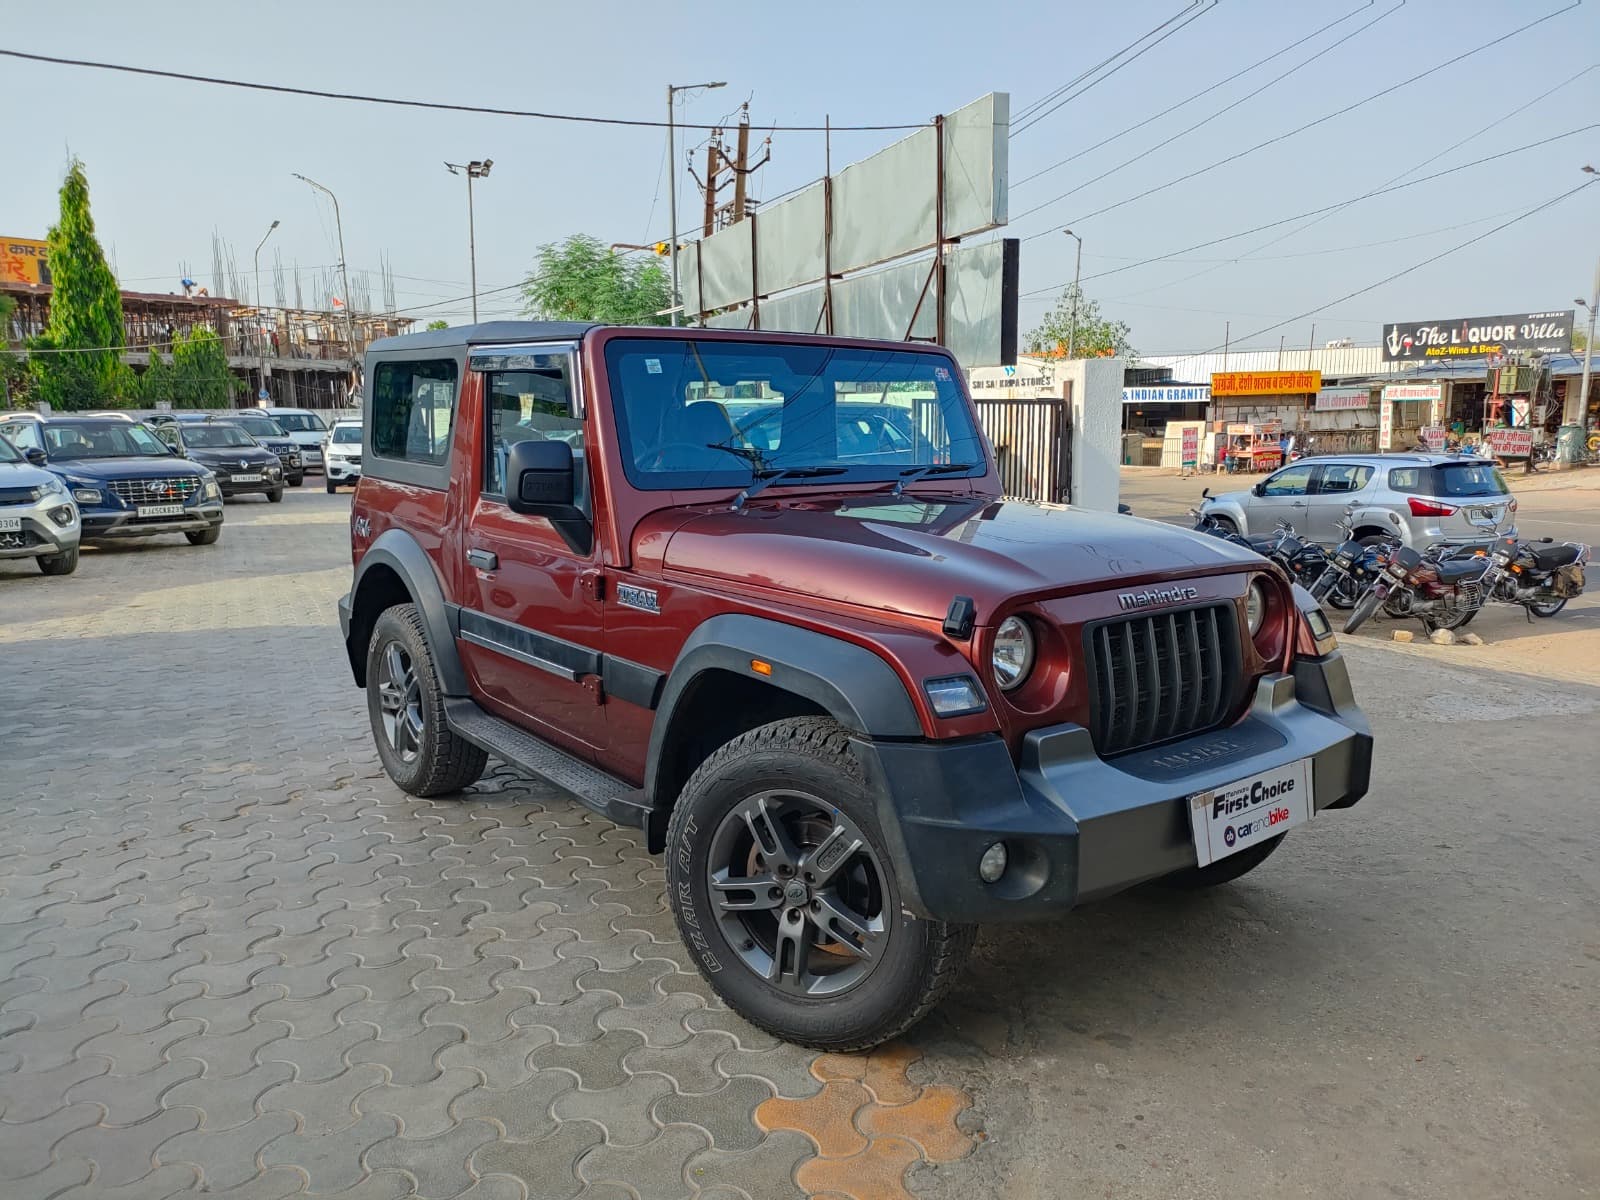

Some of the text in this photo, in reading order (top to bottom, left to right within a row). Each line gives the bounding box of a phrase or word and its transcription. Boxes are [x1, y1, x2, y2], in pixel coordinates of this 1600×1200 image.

[1414, 321, 1566, 346] The LIQUOR Villa
[1470, 346, 1478, 354] &
[1021, 376, 1051, 387] STONES
[1122, 391, 1129, 400] &
[1131, 389, 1164, 401] INDIAN
[678, 814, 698, 874] A/T
